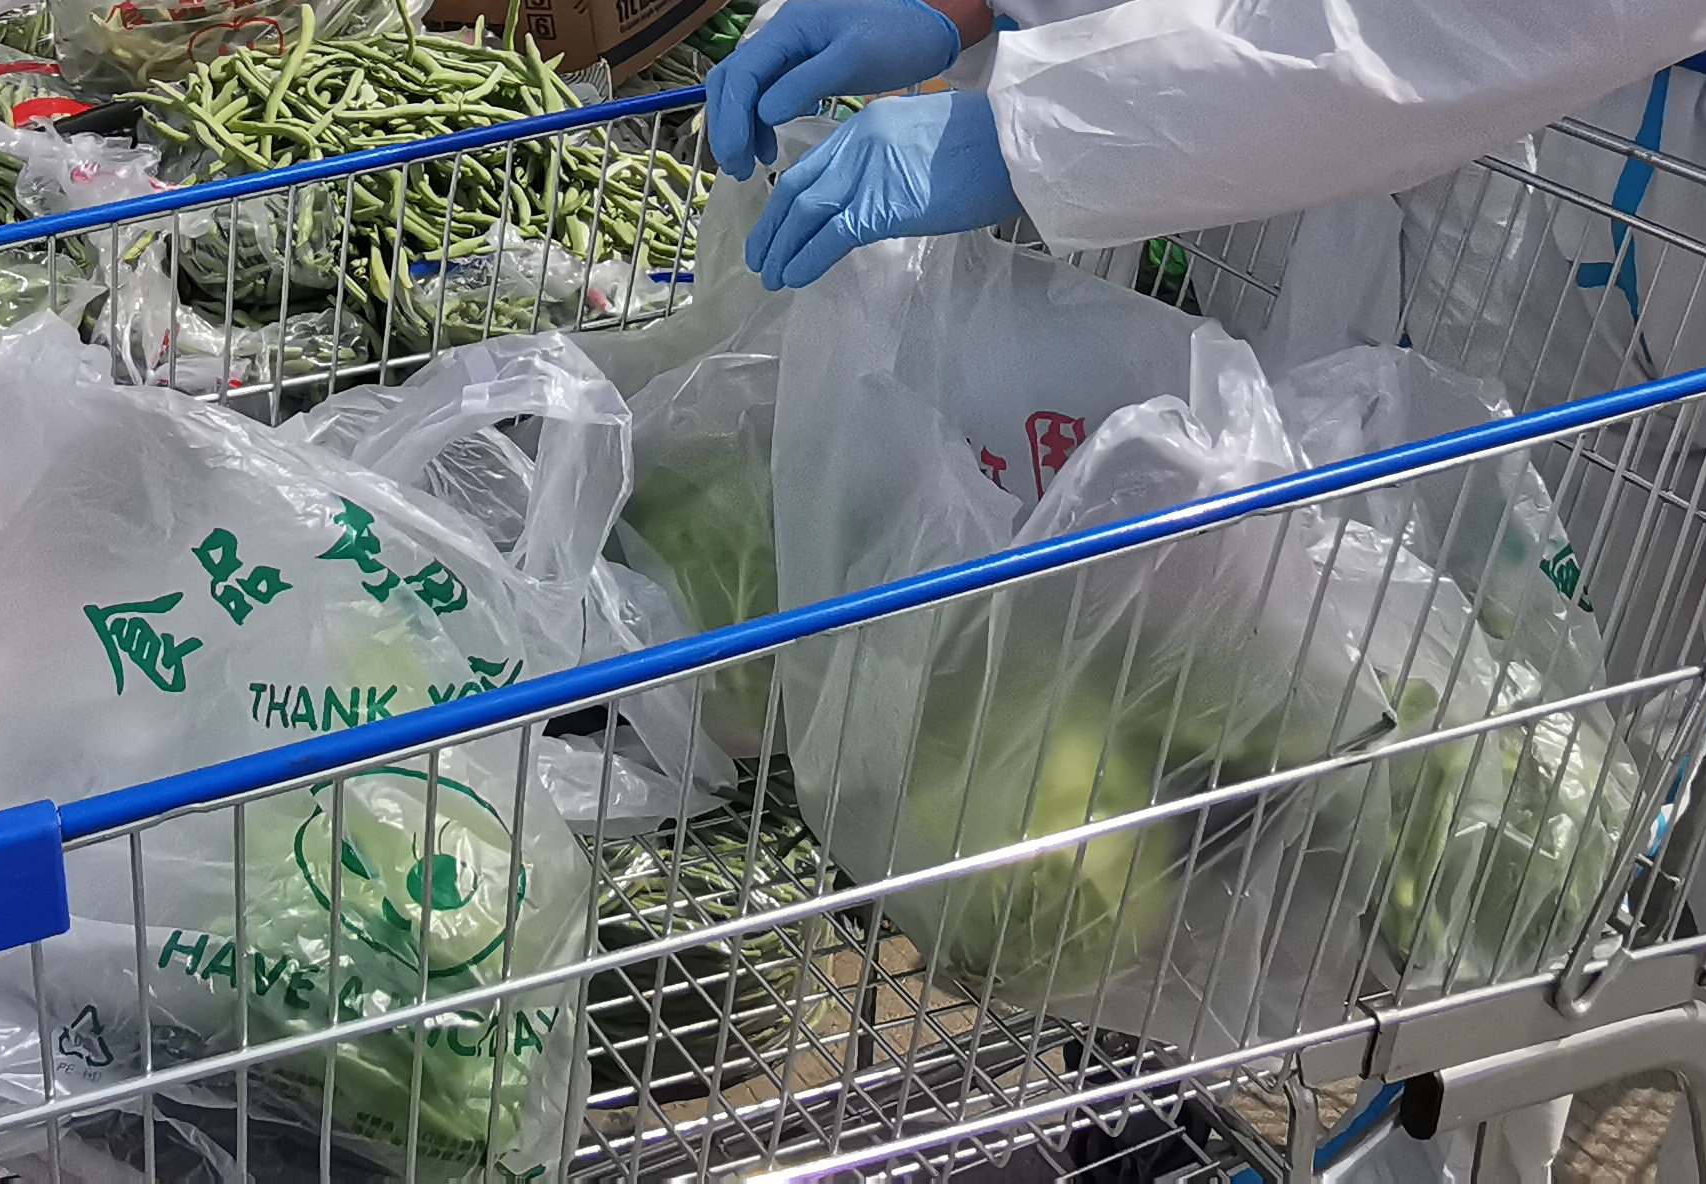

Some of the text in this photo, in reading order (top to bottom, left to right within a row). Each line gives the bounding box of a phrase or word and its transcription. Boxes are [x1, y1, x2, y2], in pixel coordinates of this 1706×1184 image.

[535, 17, 549, 38] 6
[250, 683, 398, 732] THANK
[158, 929, 320, 1010] HAVE
